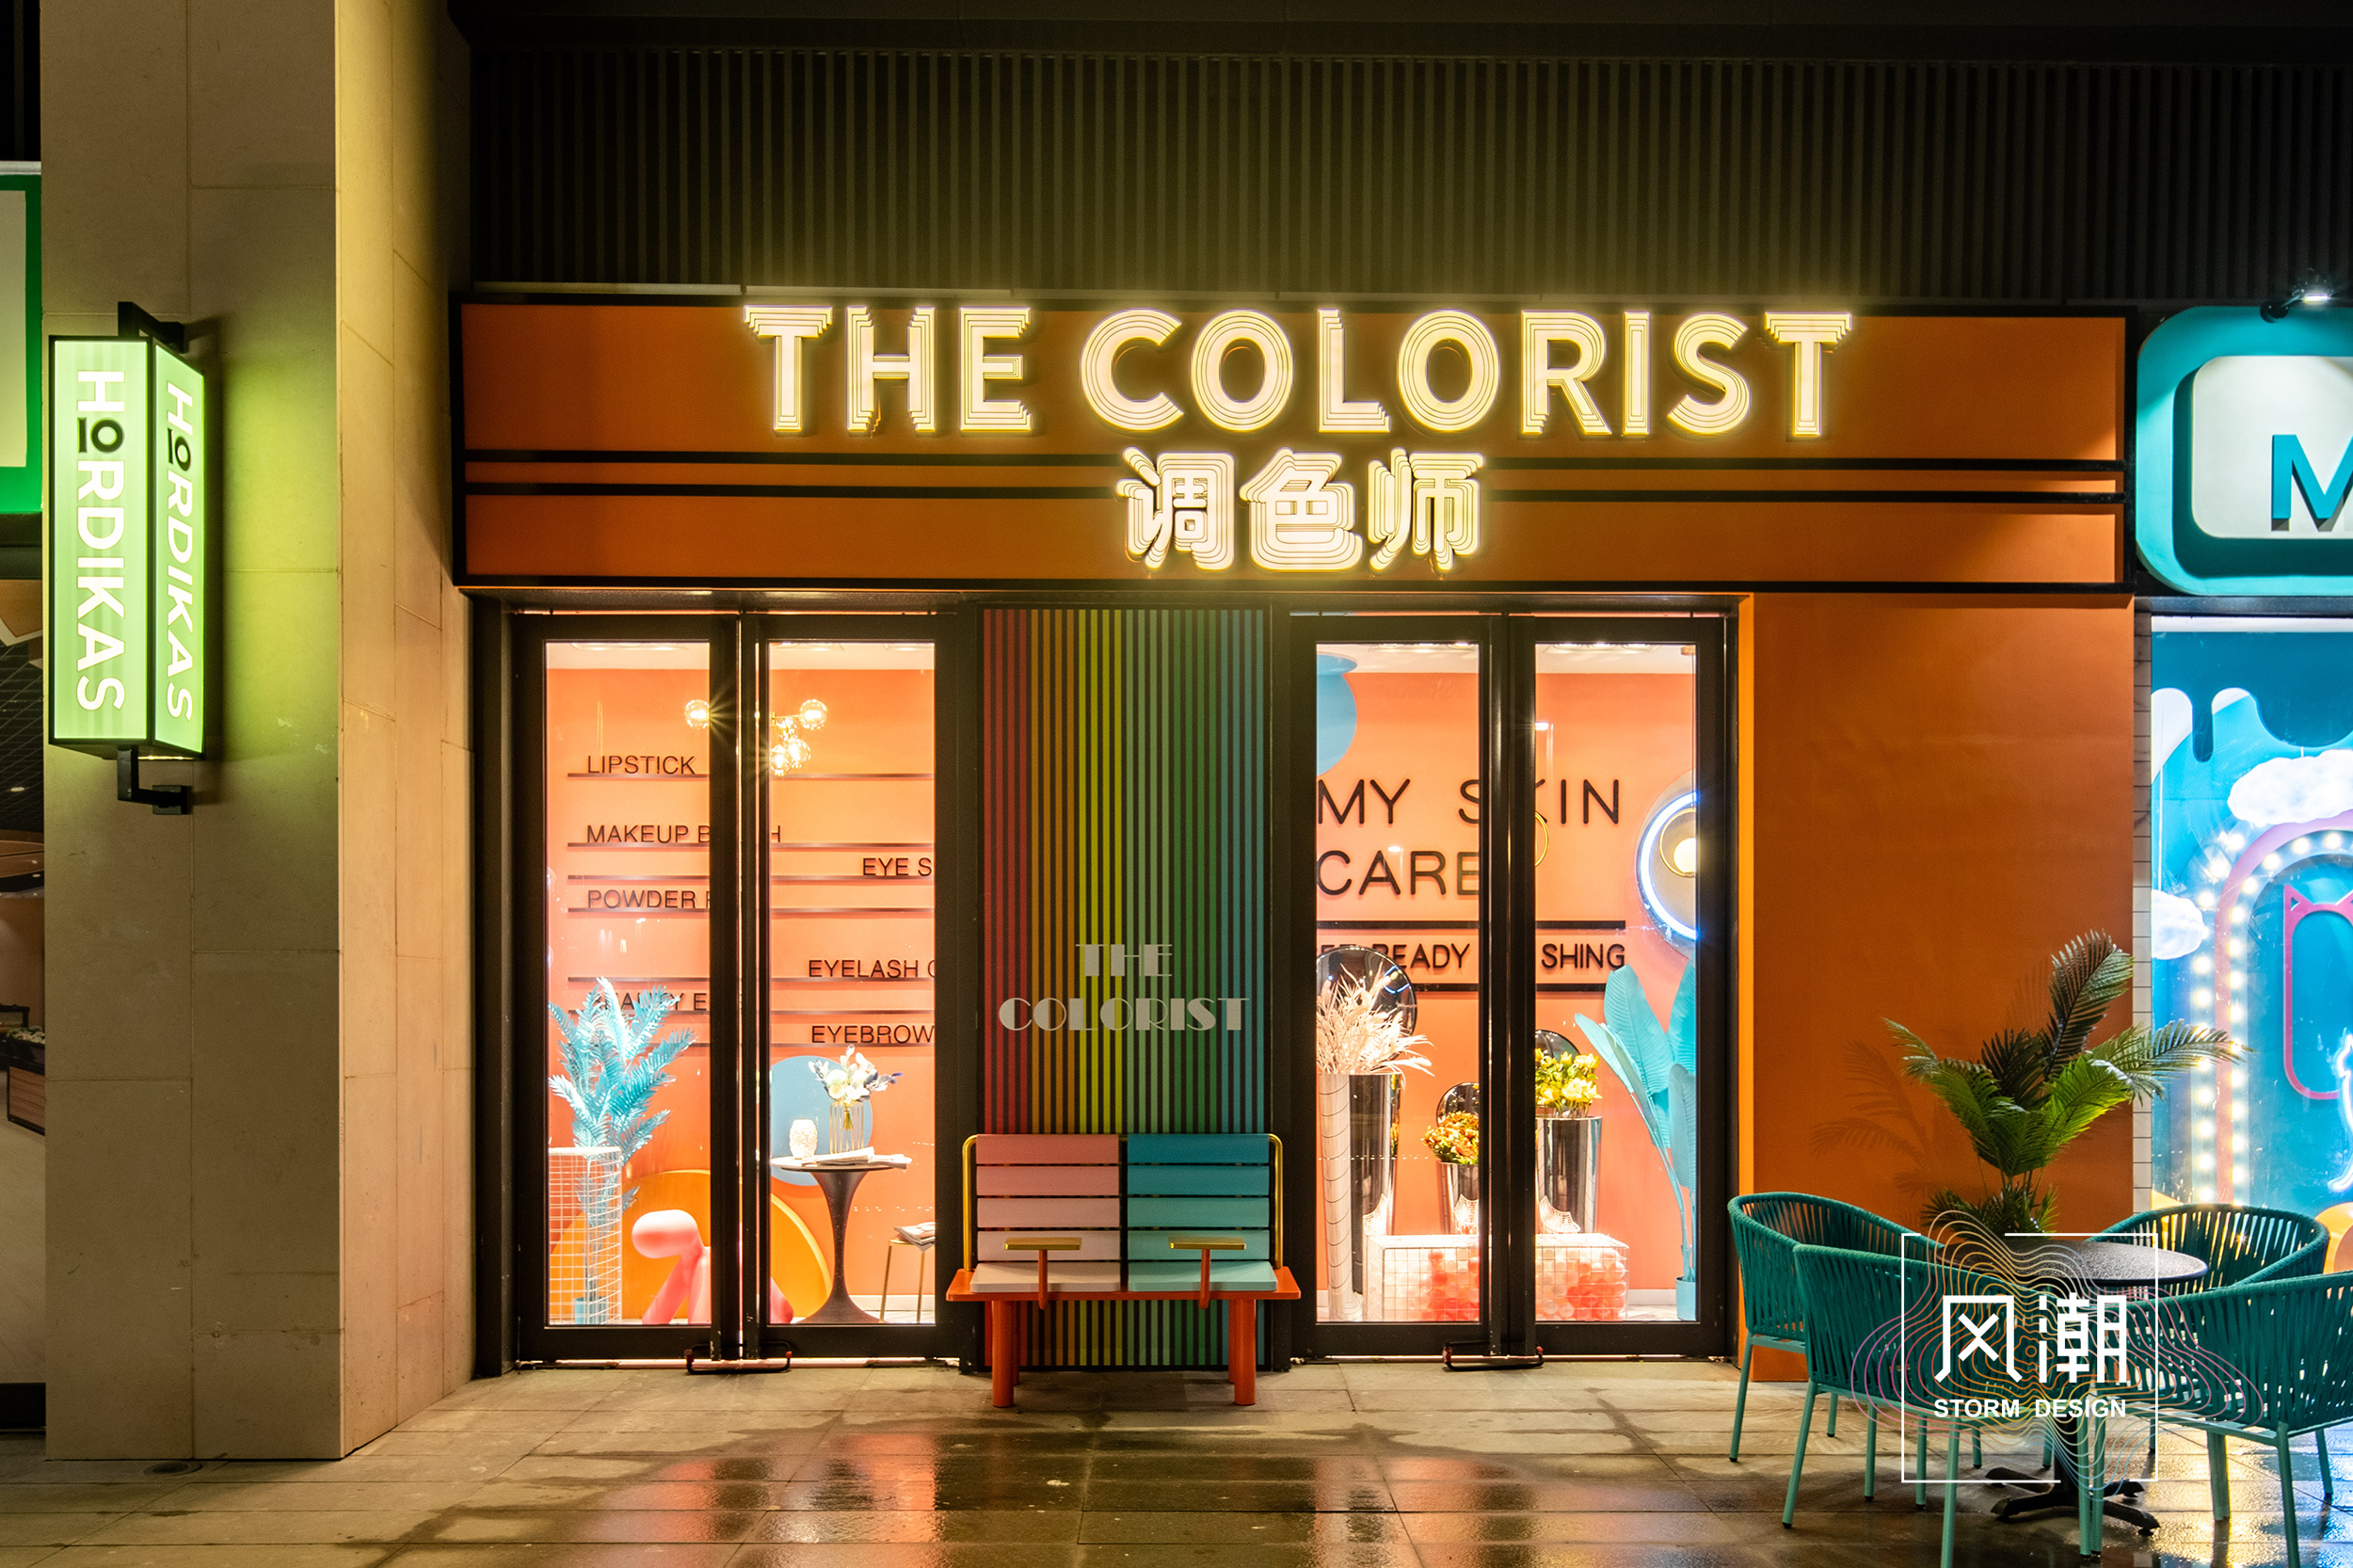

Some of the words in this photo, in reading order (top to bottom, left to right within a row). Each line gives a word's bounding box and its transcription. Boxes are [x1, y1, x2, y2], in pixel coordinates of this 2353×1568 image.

[744, 305, 1032, 432] THE
[1080, 308, 1852, 436] COLORIST
[1115, 446, 1484, 571] 调色师
[587, 755, 696, 775] LIPSTICK
[1318, 778, 1410, 824] MY
[586, 824, 689, 843] MAKEUP
[862, 857, 909, 876] EYE
[1317, 850, 1479, 895] CARE
[587, 889, 696, 908] POWDER
[808, 959, 919, 978] EYELASH
[1076, 944, 1173, 976] THE
[999, 998, 1250, 1031] COLORIST
[811, 1025, 935, 1044] EYEBROW
